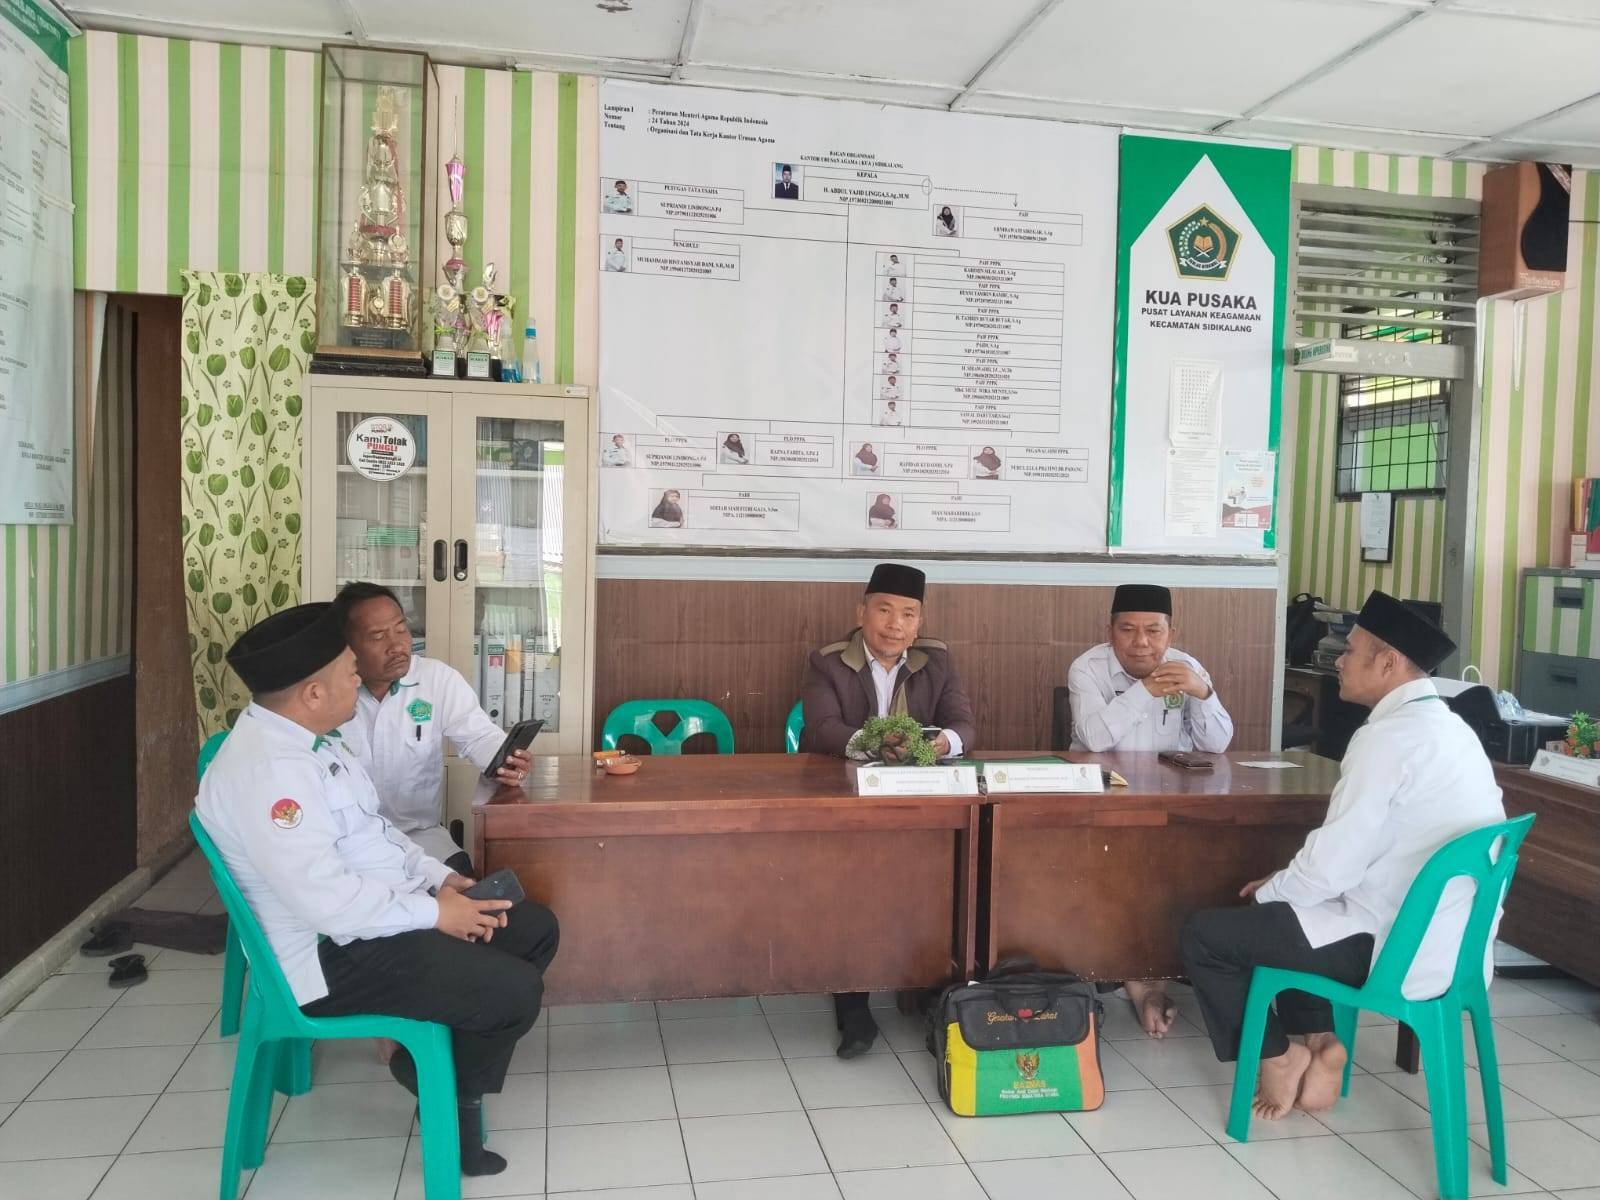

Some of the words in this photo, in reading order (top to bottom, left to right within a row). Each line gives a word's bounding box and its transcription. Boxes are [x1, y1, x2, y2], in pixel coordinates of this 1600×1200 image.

[652, 108, 678, 117] Peraturan
[680, 111, 700, 119] Menteri
[701, 113, 719, 122] Agama
[720, 115, 742, 124] Republik
[744, 116, 768, 126] Indonesia
[660, 118, 676, 126] Tahun
[650, 126, 678, 136] Organisasi
[690, 129, 702, 137] Tata
[702, 130, 718, 140] Kerja
[718, 132, 737, 140] Kantor
[1146, 290, 1182, 306] KUA
[1188, 293, 1257, 310] PUSAKA
[1142, 308, 1168, 316] PUSAT
[1170, 309, 1208, 318] LAYANAN
[1210, 311, 1261, 321] KEAGAMAAN
[1150, 320, 1200, 330] KECAMATAN
[1202, 323, 1252, 333] SIDIKALANG
[356, 434, 382, 443] Kami
[384, 436, 407, 446] Tolak
